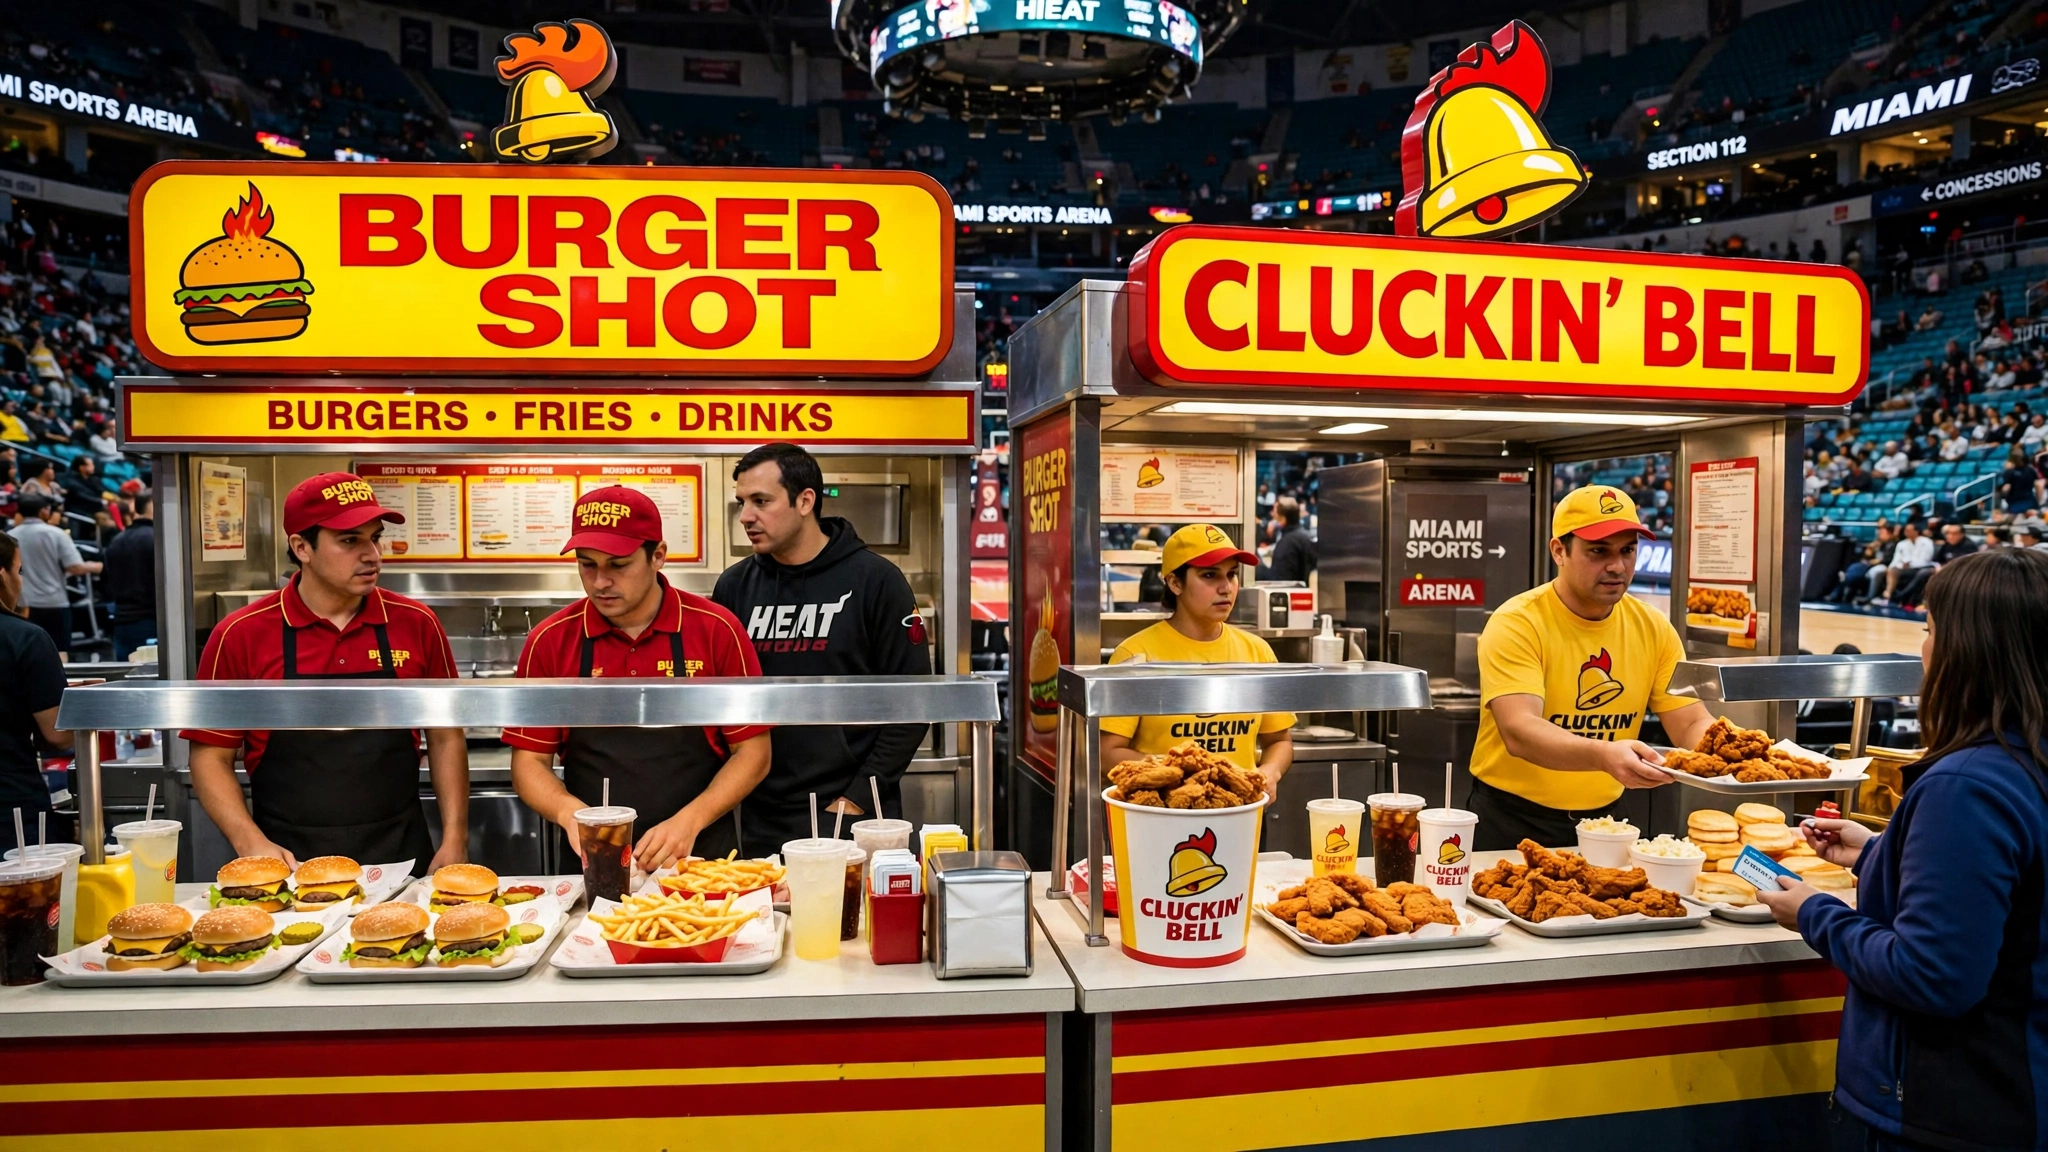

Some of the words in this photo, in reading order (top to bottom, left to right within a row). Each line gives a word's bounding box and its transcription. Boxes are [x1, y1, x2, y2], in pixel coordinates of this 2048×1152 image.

[29, 80, 121, 120] SPORTS
[125, 103, 199, 138] ARENA
[1829, 73, 1973, 136] MIAMI
[1647, 141, 1718, 170] SECTION
[1720, 135, 1747, 156] 112
[1935, 161, 2042, 200] CONCESSIONS
[954, 204, 984, 222] AMI
[987, 205, 1053, 223] SPORTS
[1055, 206, 1113, 224] ARENA
[339, 193, 882, 272] BURGER
[476, 274, 837, 350] SHOT
[1183, 258, 1624, 364] CLUCKIN'
[1642, 285, 1836, 375] BELL
[267, 399, 469, 431] BURGERS
[514, 400, 632, 432] FRIES
[678, 402, 834, 433] DRINKS
[1023, 447, 1067, 497] BURGER
[321, 480, 374, 500] BURG
[337, 490, 374, 506] SHOT
[576, 501, 631, 518] BURGER
[580, 513, 621, 528] SHOT
[1029, 491, 1060, 534] SHOT
[1408, 518, 1483, 539] MIAMI
[1406, 540, 1483, 559] SPORTS
[1407, 583, 1475, 601] ARENA
[746, 590, 853, 640] HEAT
[1170, 718, 1255, 738] CLUCKIN'
[1549, 711, 1638, 730] CLUCKIN'
[1436, 877, 1463, 886] BELL
[1140, 893, 1244, 921] CLUCKIN'
[1166, 921, 1223, 942] BELL
